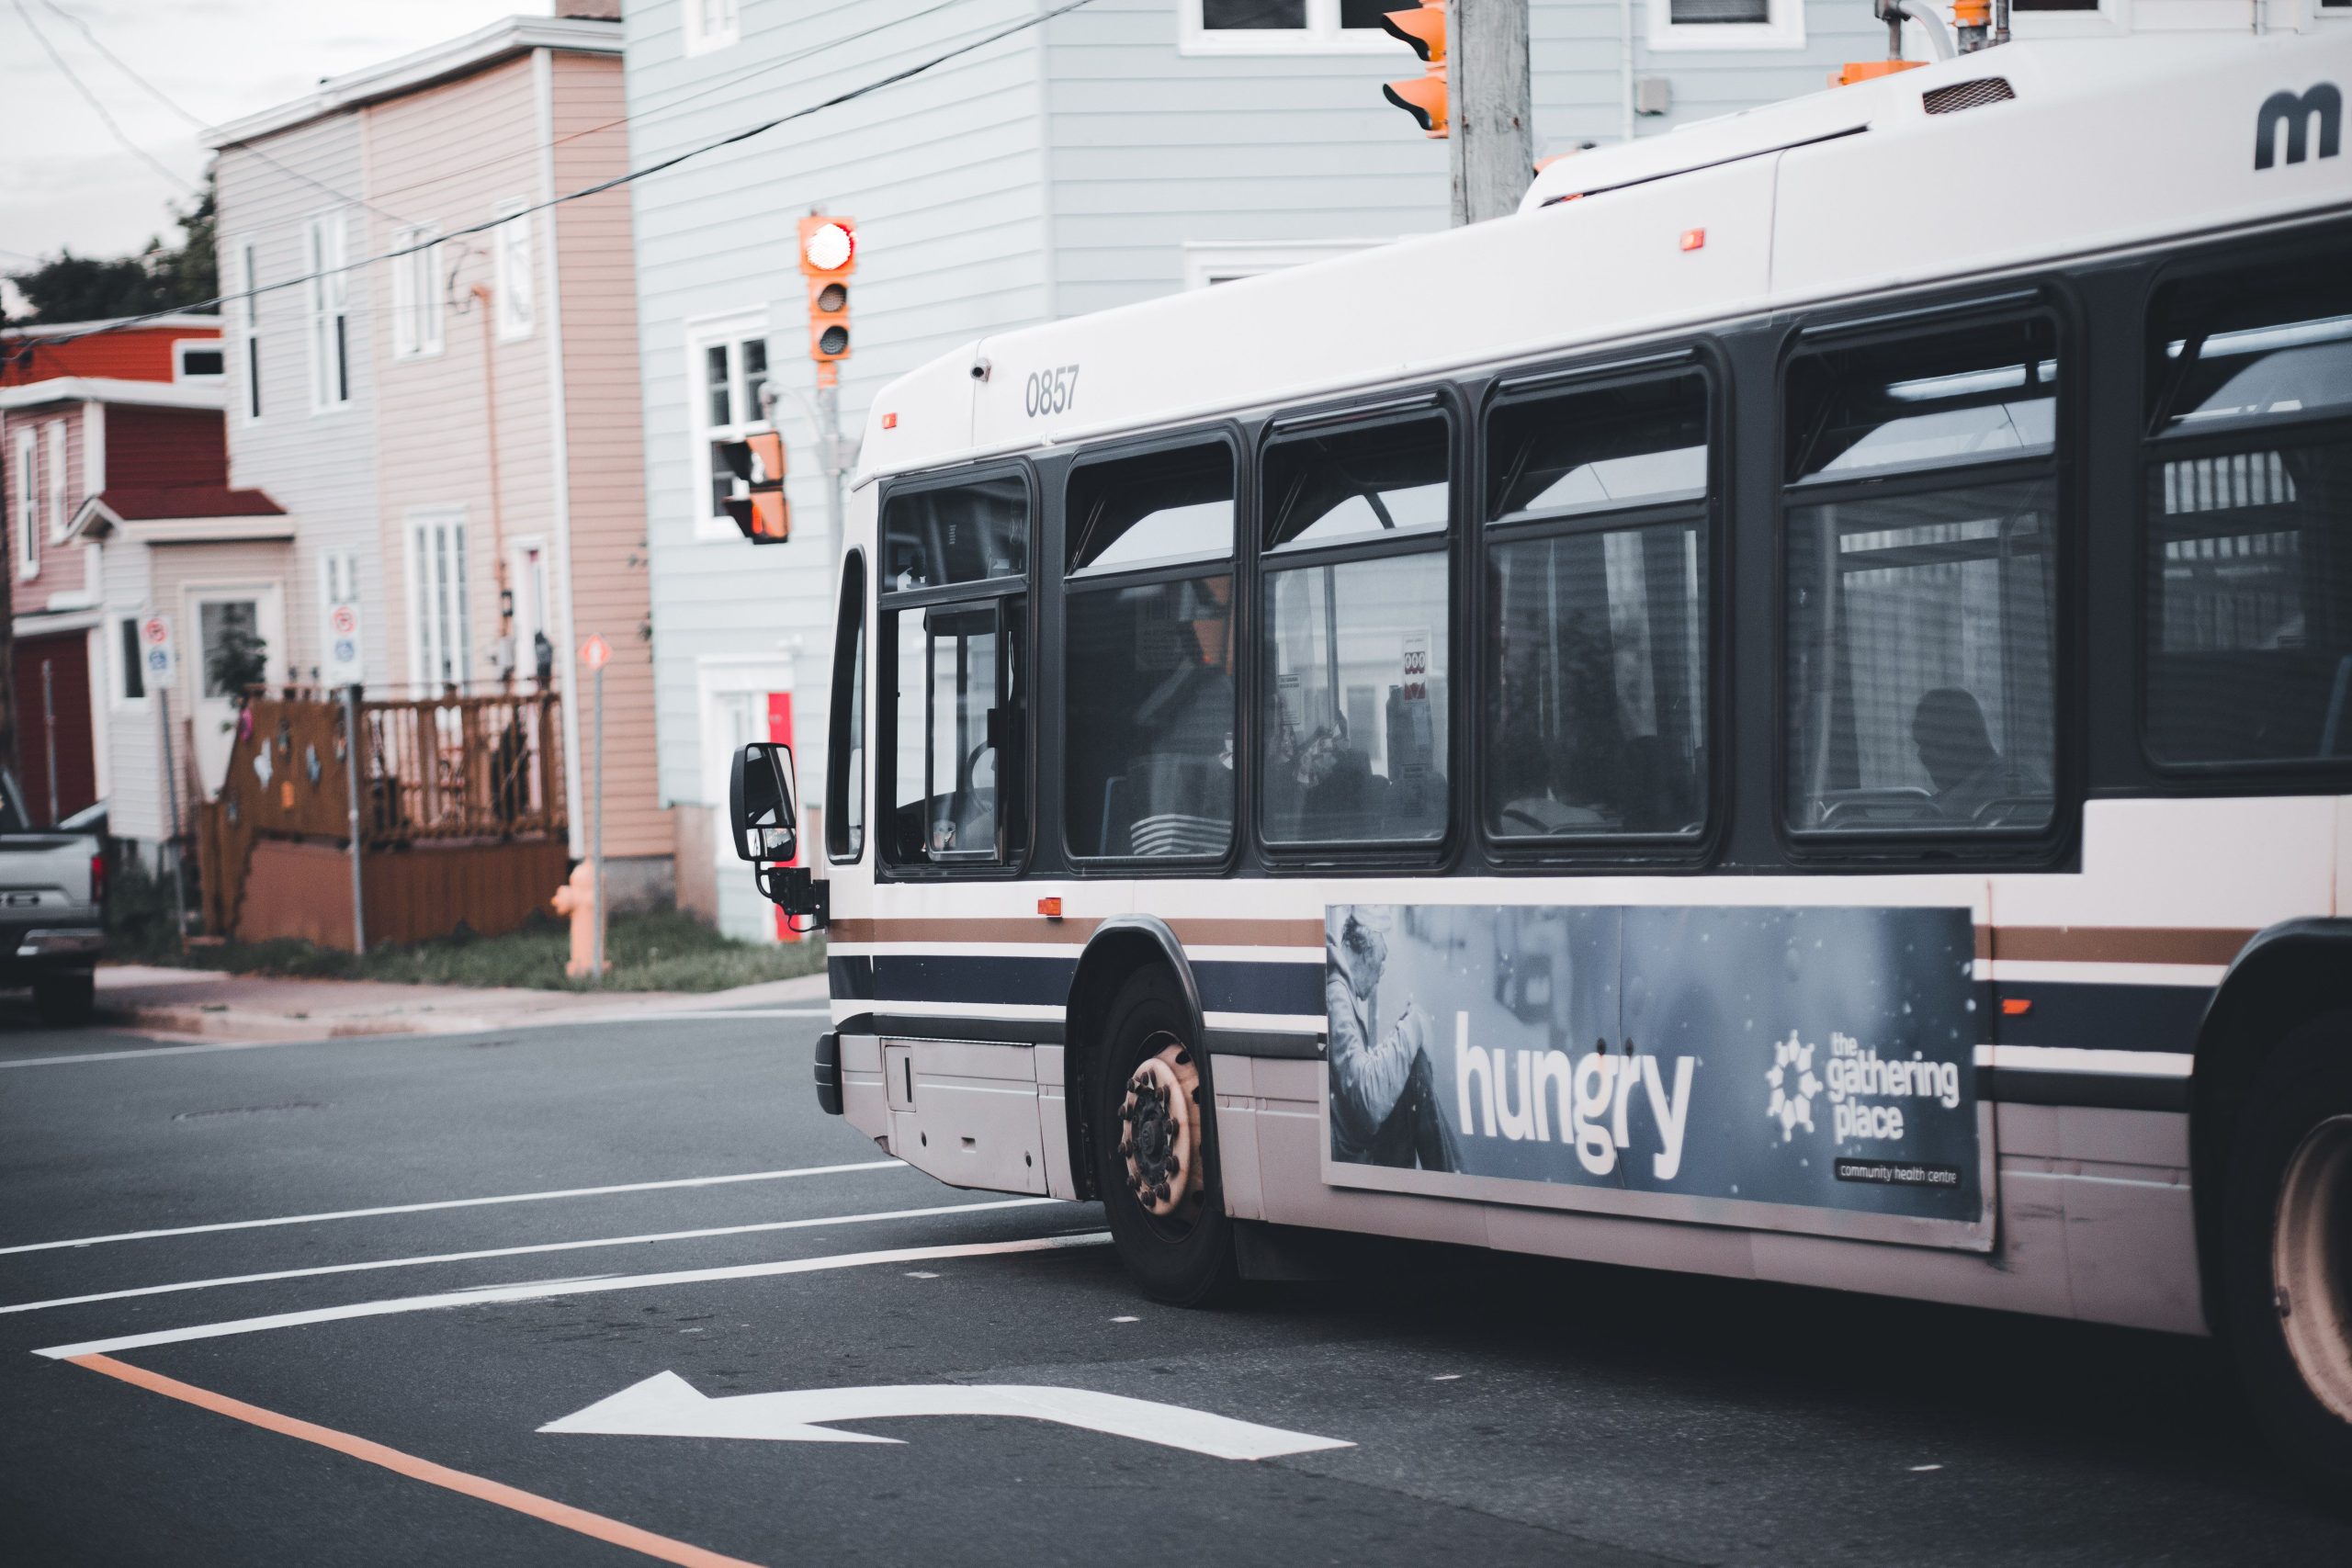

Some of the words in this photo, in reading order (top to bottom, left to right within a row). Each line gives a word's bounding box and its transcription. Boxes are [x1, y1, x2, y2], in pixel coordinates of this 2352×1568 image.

[2254, 82, 2342, 171] m
[1026, 364, 1080, 418] 0857
[1831, 1032, 1858, 1056] the
[1456, 1011, 1695, 1180] hungry
[1826, 1047, 1960, 1109] gathering
[1834, 1097, 1904, 1145] place
[1840, 1165, 1892, 1182] community
[1894, 1166, 1926, 1181] health
[1928, 1168, 1956, 1183] centre
